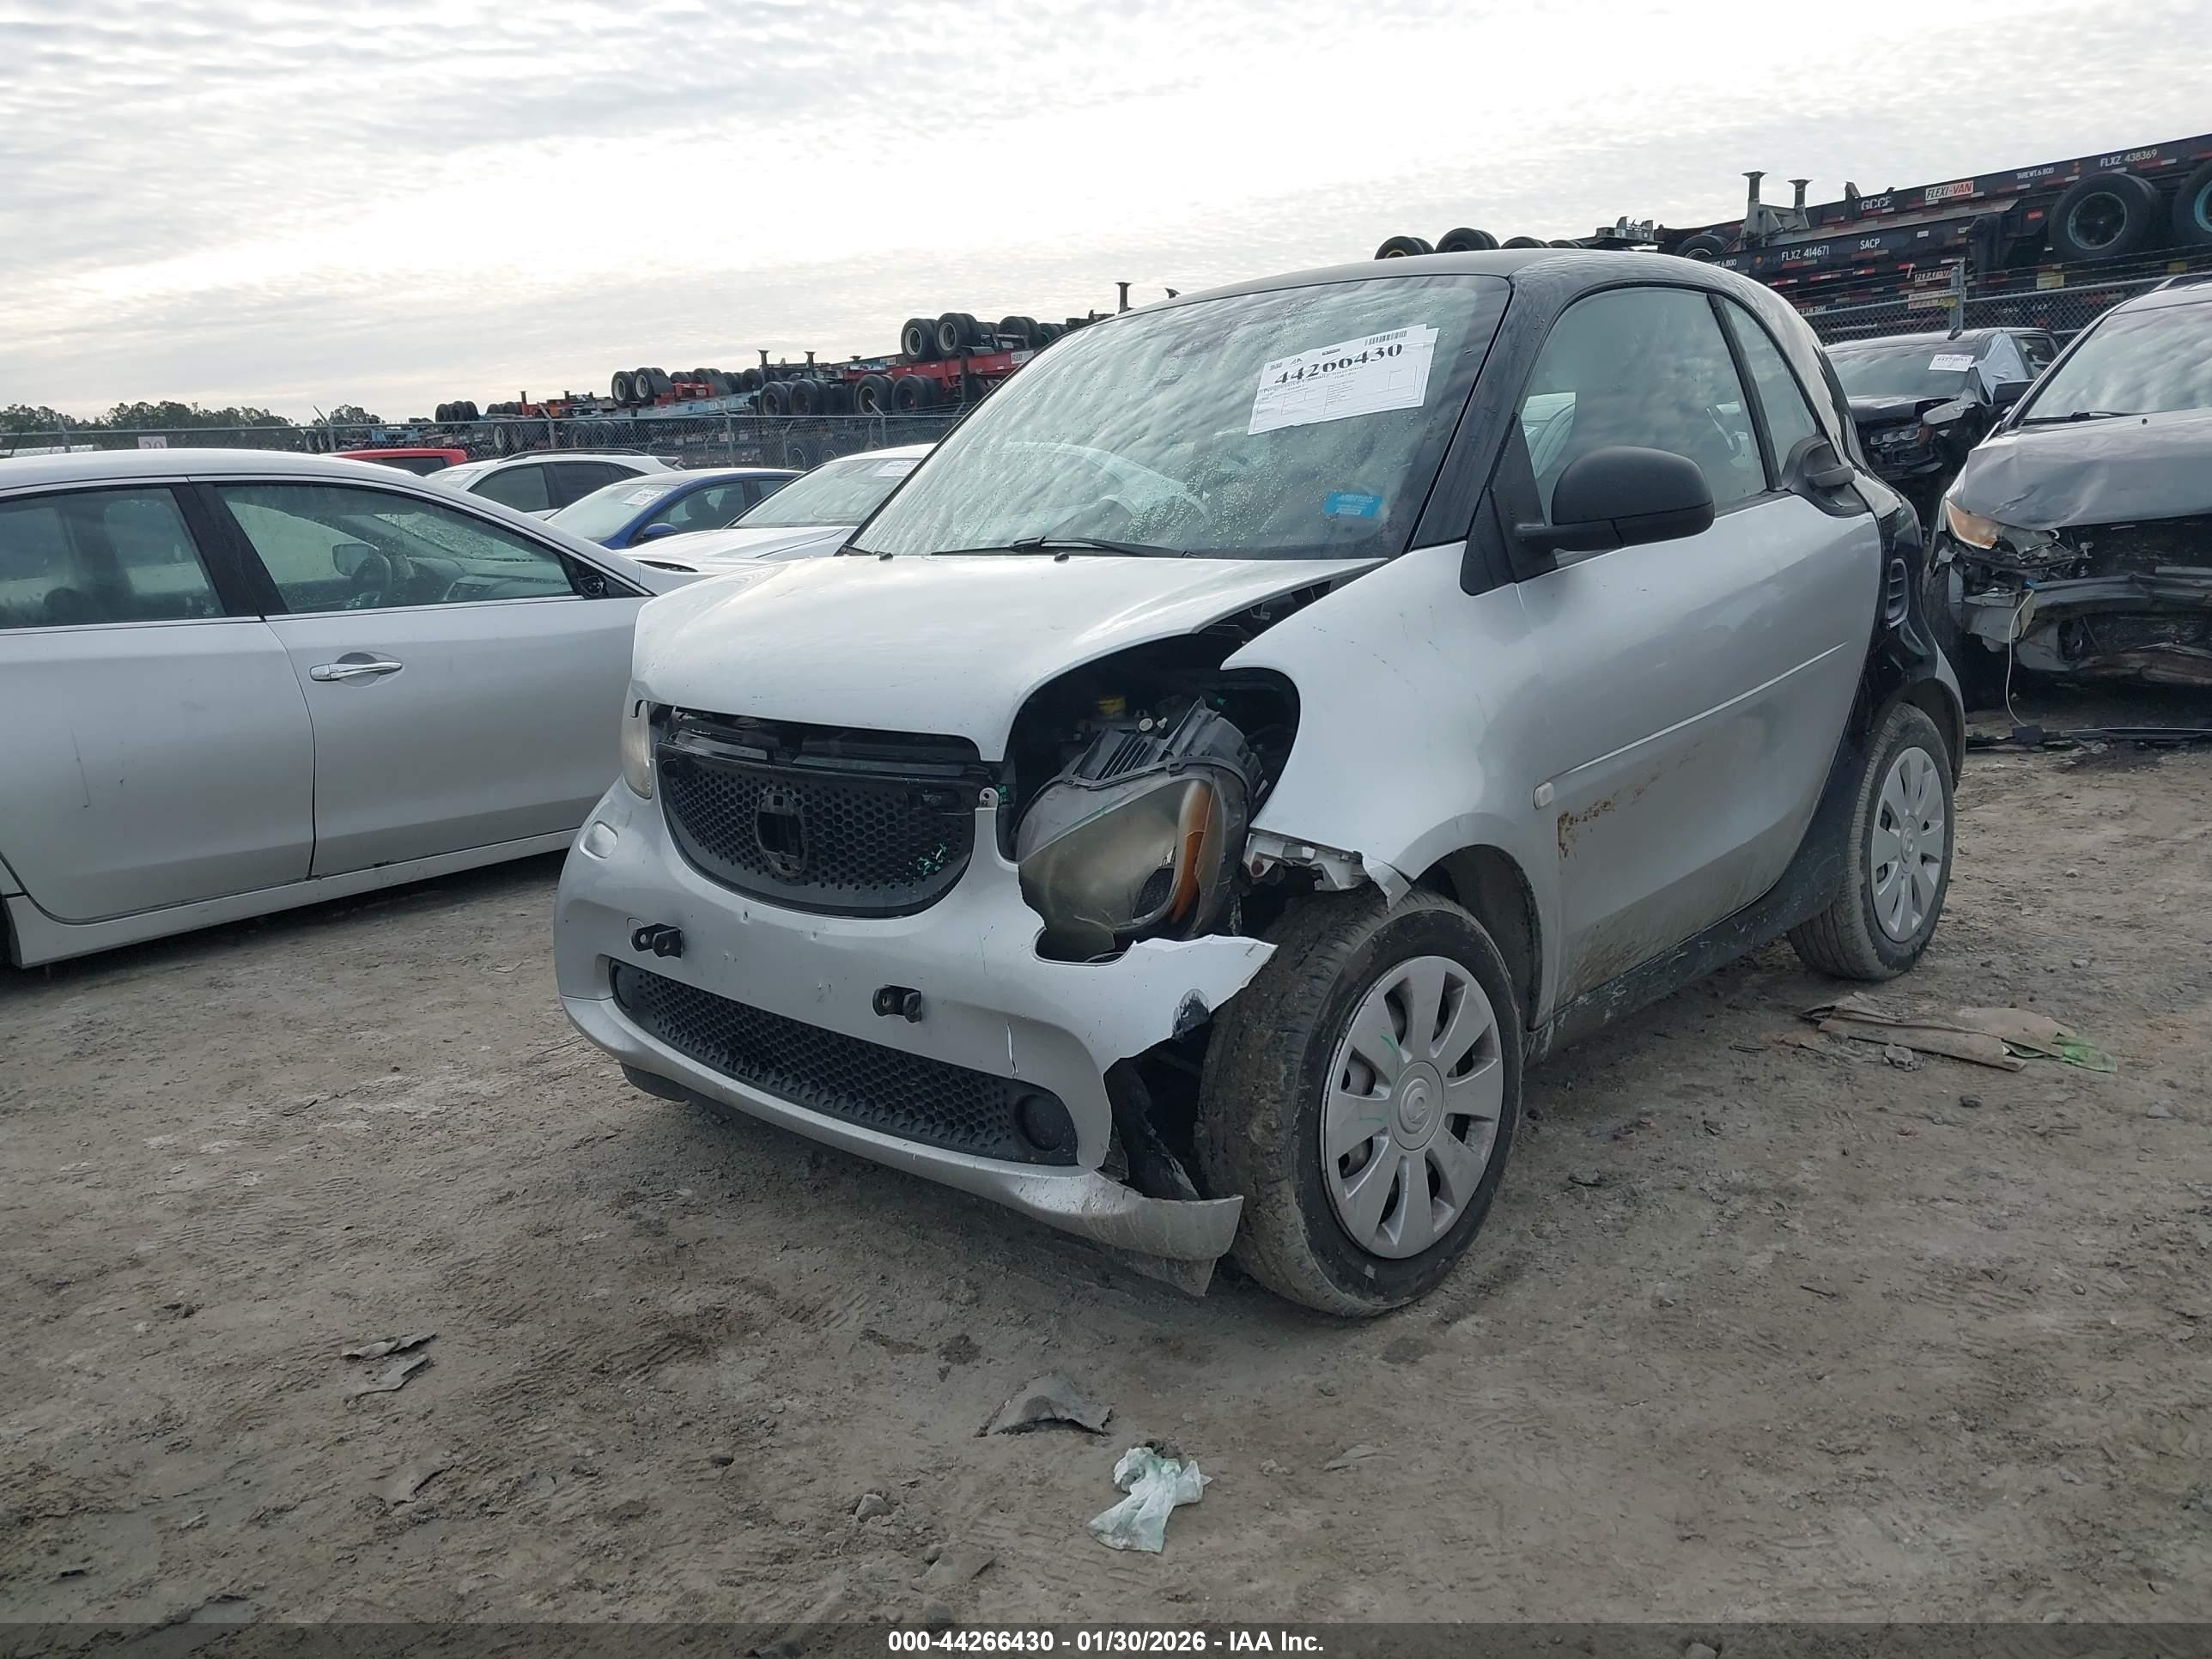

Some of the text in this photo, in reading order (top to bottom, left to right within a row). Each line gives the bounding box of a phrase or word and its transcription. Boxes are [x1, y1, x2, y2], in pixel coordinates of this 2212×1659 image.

[2100, 149, 2157, 167] FLXZ 438369
[1926, 182, 1972, 198] FLEXI-VAN
[1860, 238, 1881, 250] SACP
[1781, 245, 1829, 262] FLXZ 414671
